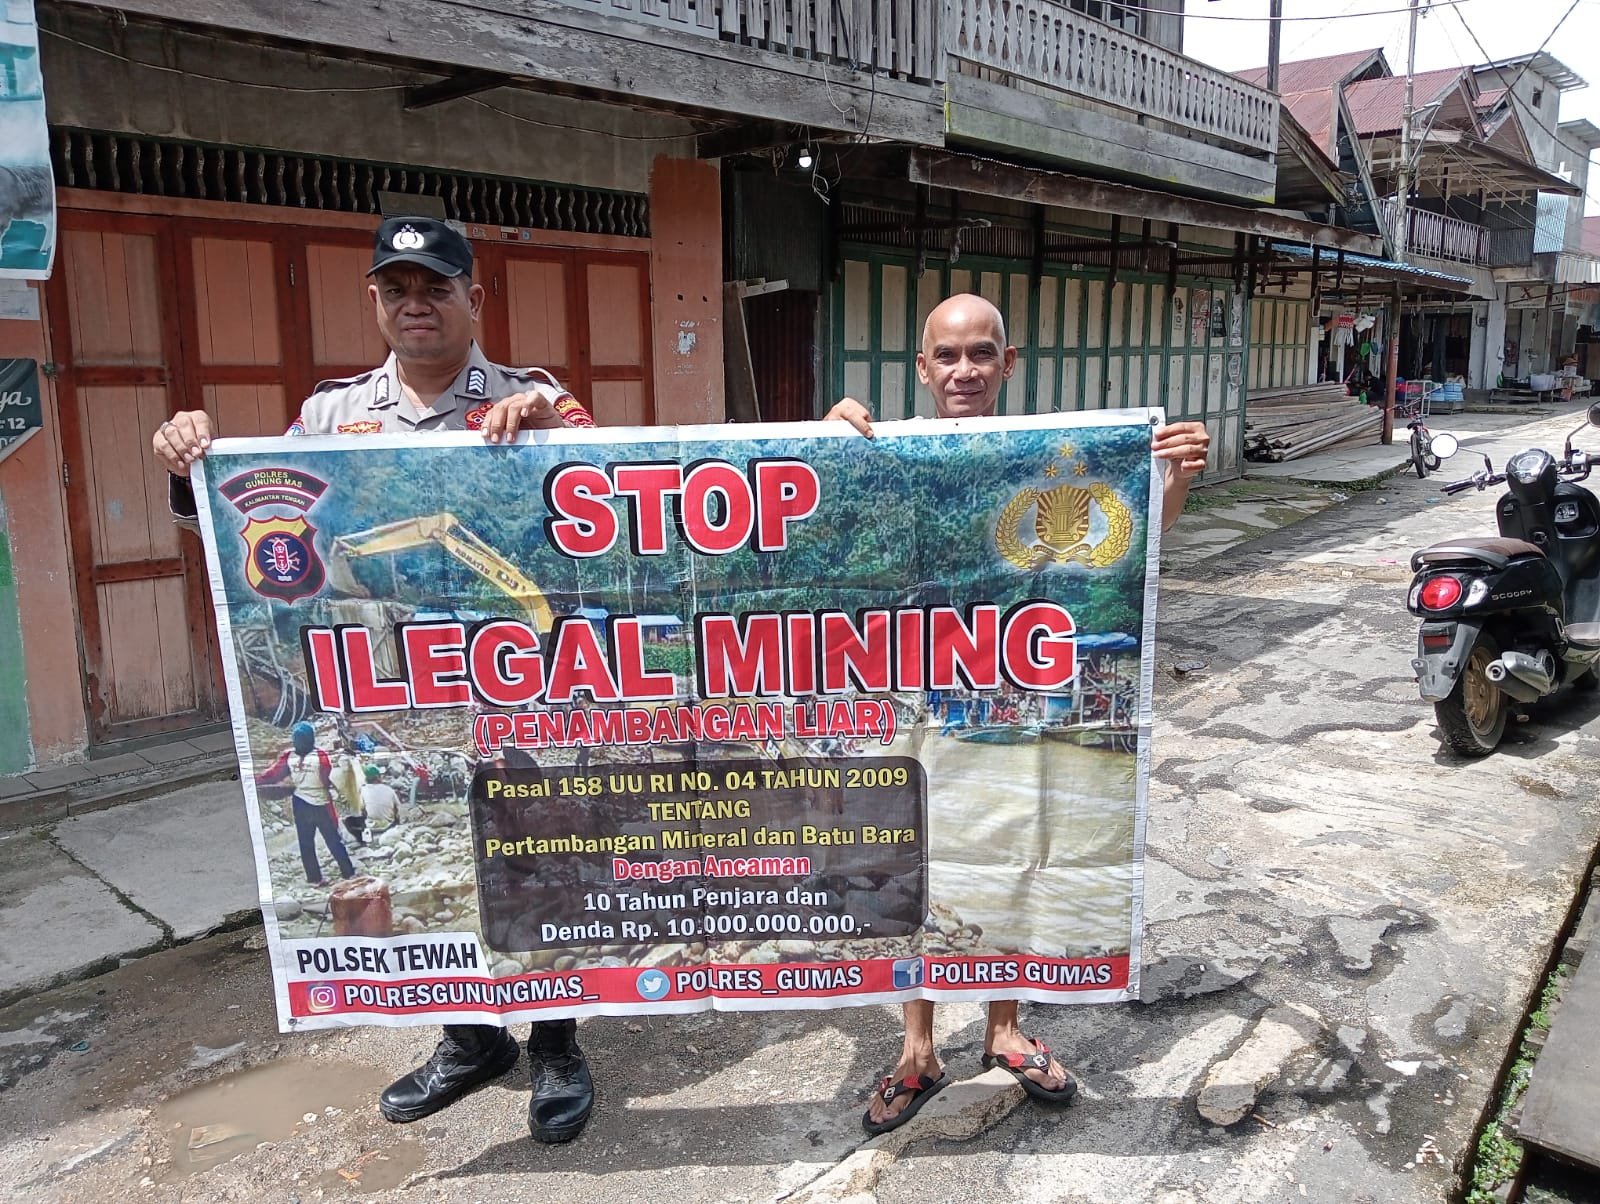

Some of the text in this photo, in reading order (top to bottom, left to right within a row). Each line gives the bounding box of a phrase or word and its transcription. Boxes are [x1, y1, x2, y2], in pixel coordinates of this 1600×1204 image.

[8, 417, 26, 430] 12
[245, 477, 303, 489] GUNUNG MAS
[253, 471, 289, 480] POLRES
[244, 494, 305, 508] KALIMANTAN TENGAH
[547, 458, 820, 558] STOP
[1491, 589, 1532, 601] SCOOPY
[302, 600, 1077, 712] ILEGAL MINING
[474, 699, 897, 757] (PENAMBANGAN LIAR)
[486, 767, 908, 799] Pasal 158 UU RI NO. 04 TAHUN 2009
[648, 799, 751, 822] TENTANG
[485, 825, 915, 858] Pertambangan Mineral dan Batu Bara
[612, 854, 811, 883] Dengan Ancaman
[583, 886, 828, 912] 10 Tahun Penjara dan
[541, 913, 872, 942] Denda Rp. 10.000.000.000,-
[296, 943, 479, 974] POLSEK TEWAH
[676, 966, 862, 995] POLRES_GUMAS
[930, 962, 1113, 986] POLRES GUMAS
[343, 975, 600, 1008] POLRESGUNUNGMAS_
